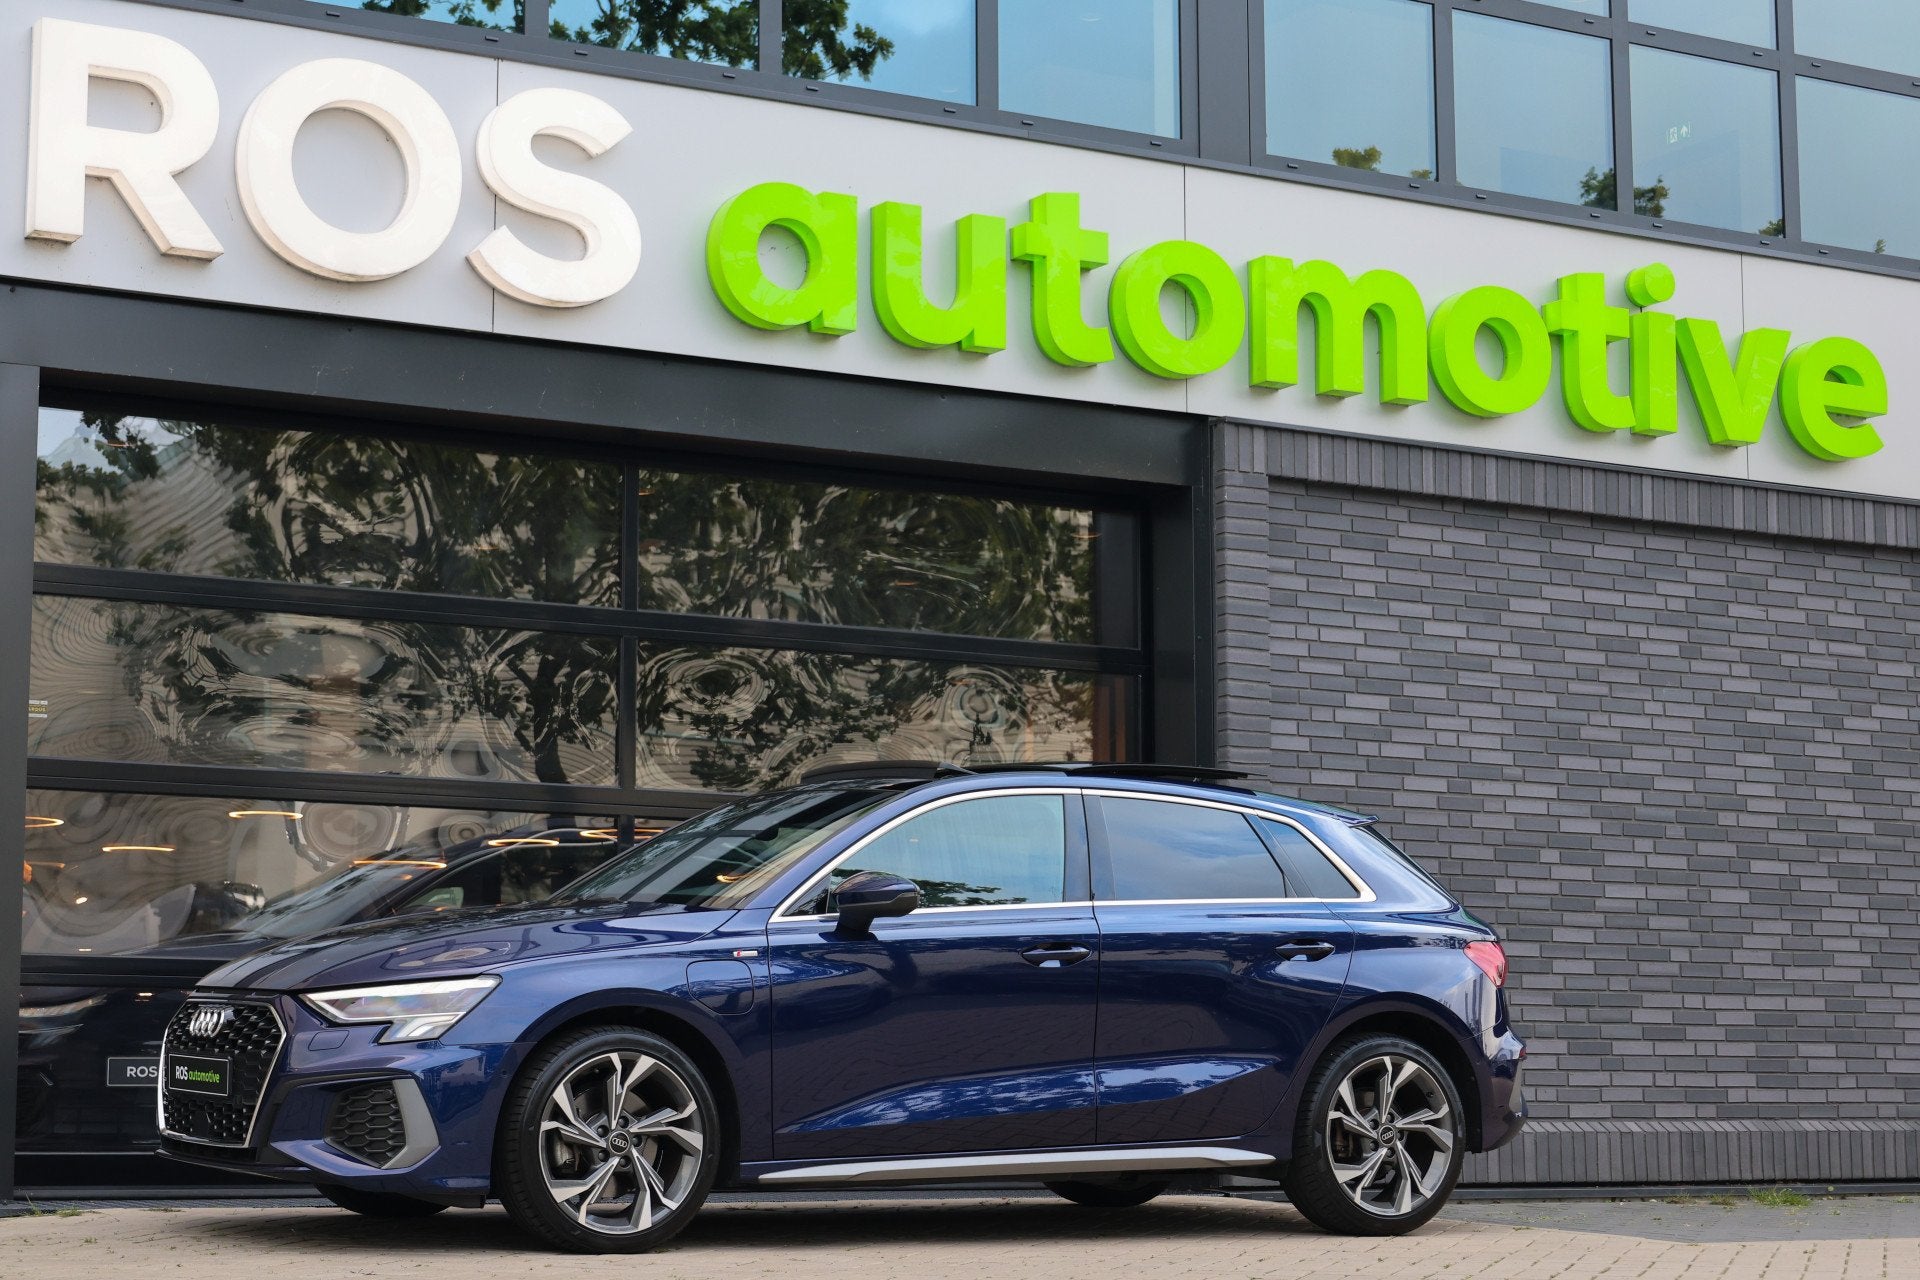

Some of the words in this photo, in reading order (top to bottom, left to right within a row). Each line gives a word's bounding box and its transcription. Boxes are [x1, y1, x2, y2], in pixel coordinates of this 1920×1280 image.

[25, 17, 641, 307] ROS
[707, 183, 1888, 461] automotive
[127, 1066, 158, 1077] ROS
[175, 1066, 188, 1080] ROS
[189, 1070, 220, 1083] automotive
